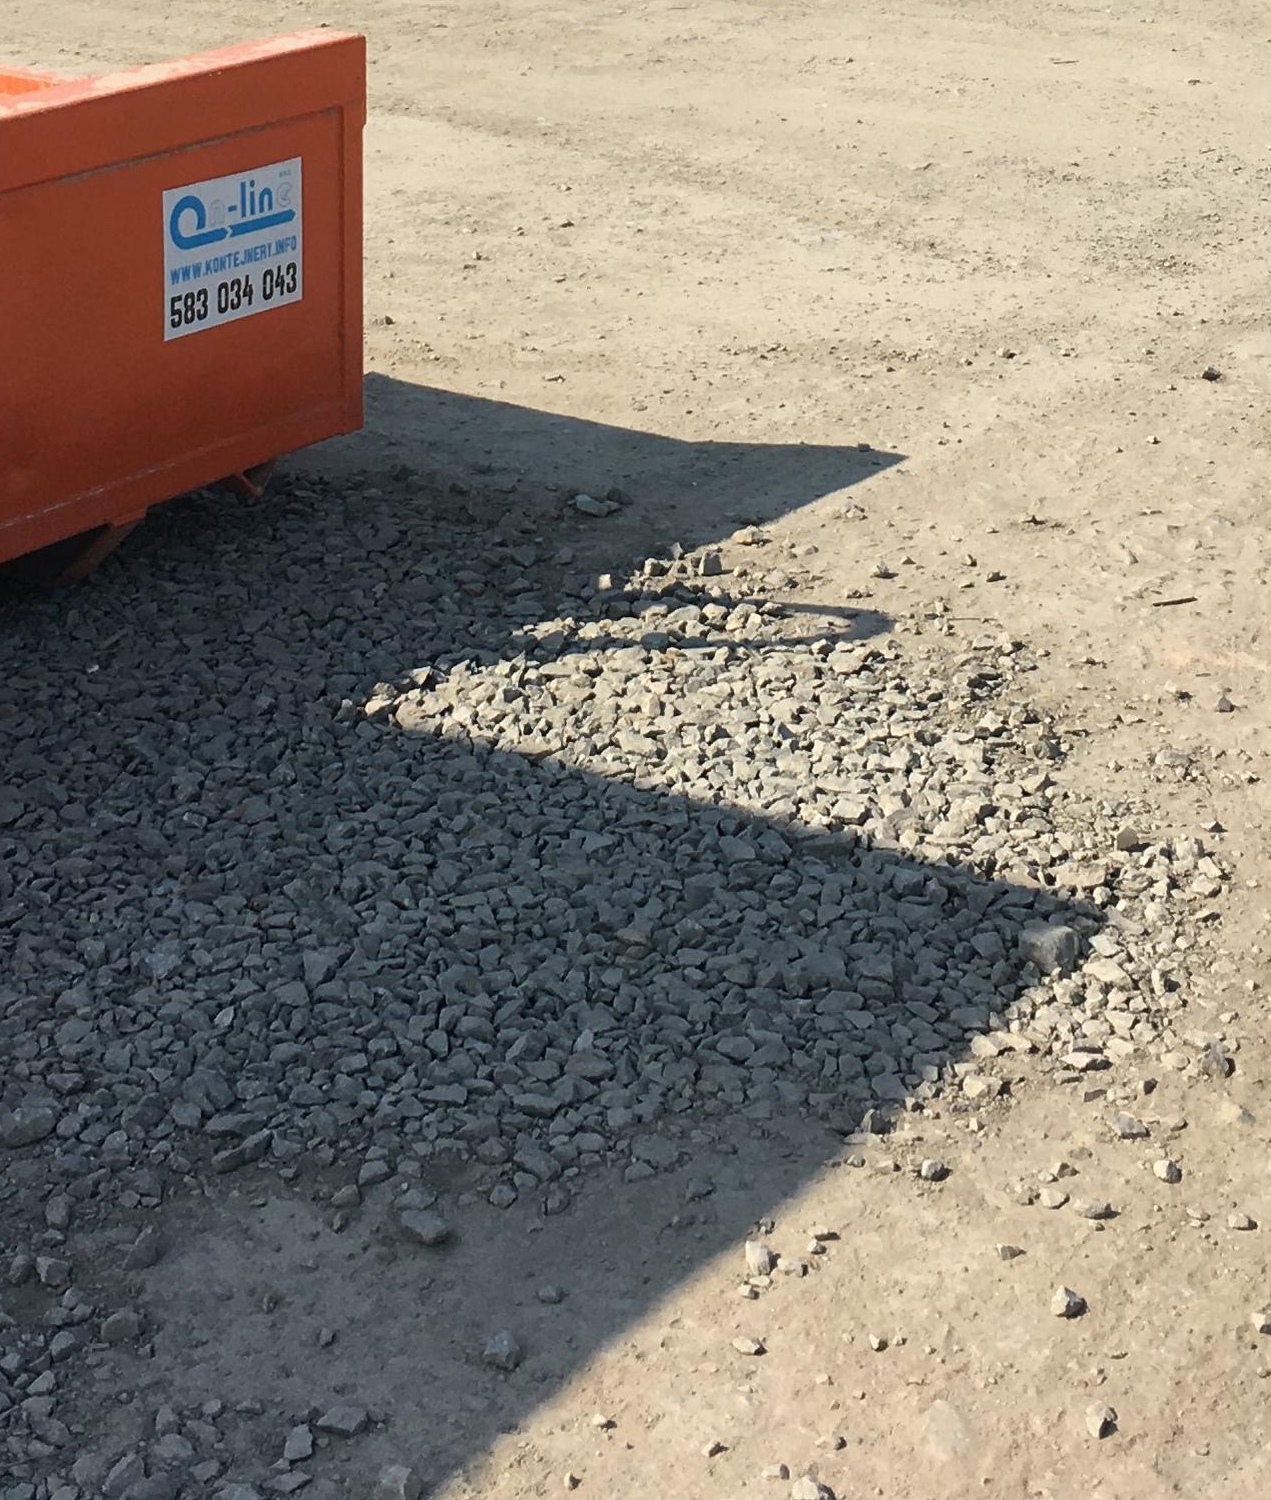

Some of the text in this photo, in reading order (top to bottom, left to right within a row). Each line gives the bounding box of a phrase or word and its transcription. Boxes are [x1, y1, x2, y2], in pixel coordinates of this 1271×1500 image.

[170, 235, 297, 286] WWW.KONTEJNERY.INFO
[170, 261, 298, 328] 583 034 043
